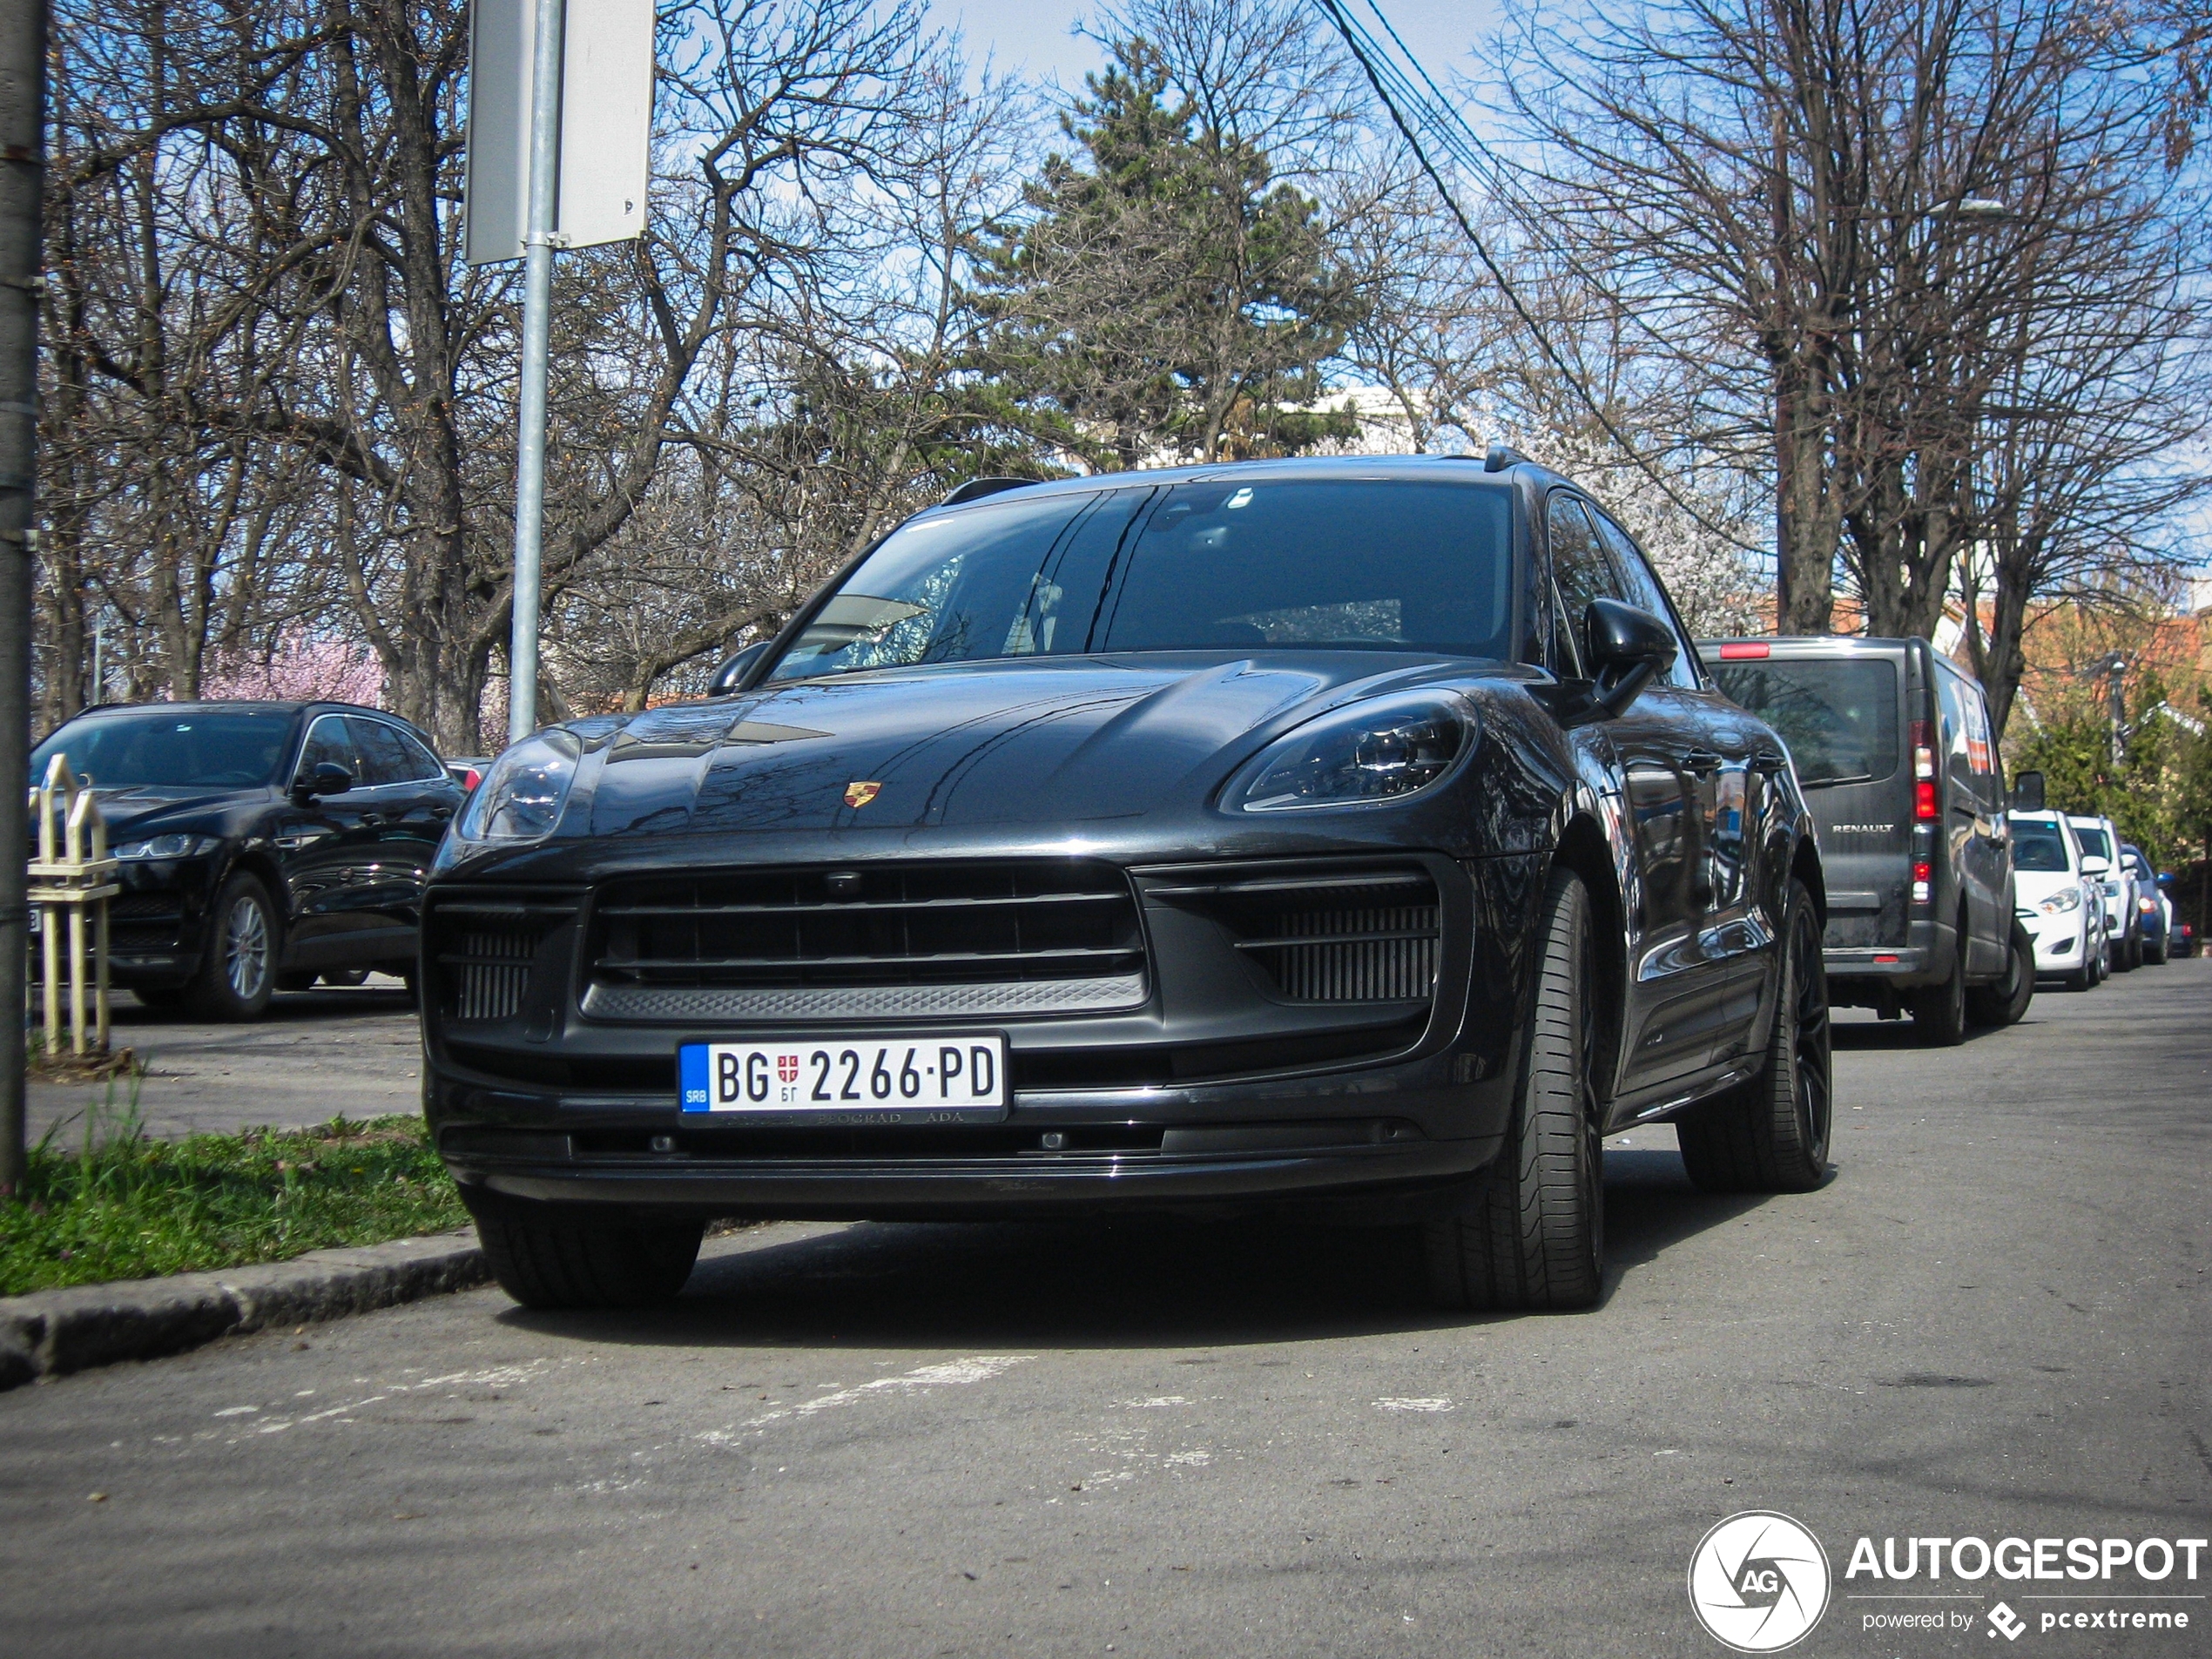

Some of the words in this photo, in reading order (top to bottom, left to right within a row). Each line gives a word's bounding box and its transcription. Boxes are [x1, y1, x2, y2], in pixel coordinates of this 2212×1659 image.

[1832, 824, 1894, 833] RENAULT
[718, 1051, 769, 1103] BG
[685, 1089, 707, 1103] SRB
[926, 1111, 964, 1123] ADA
